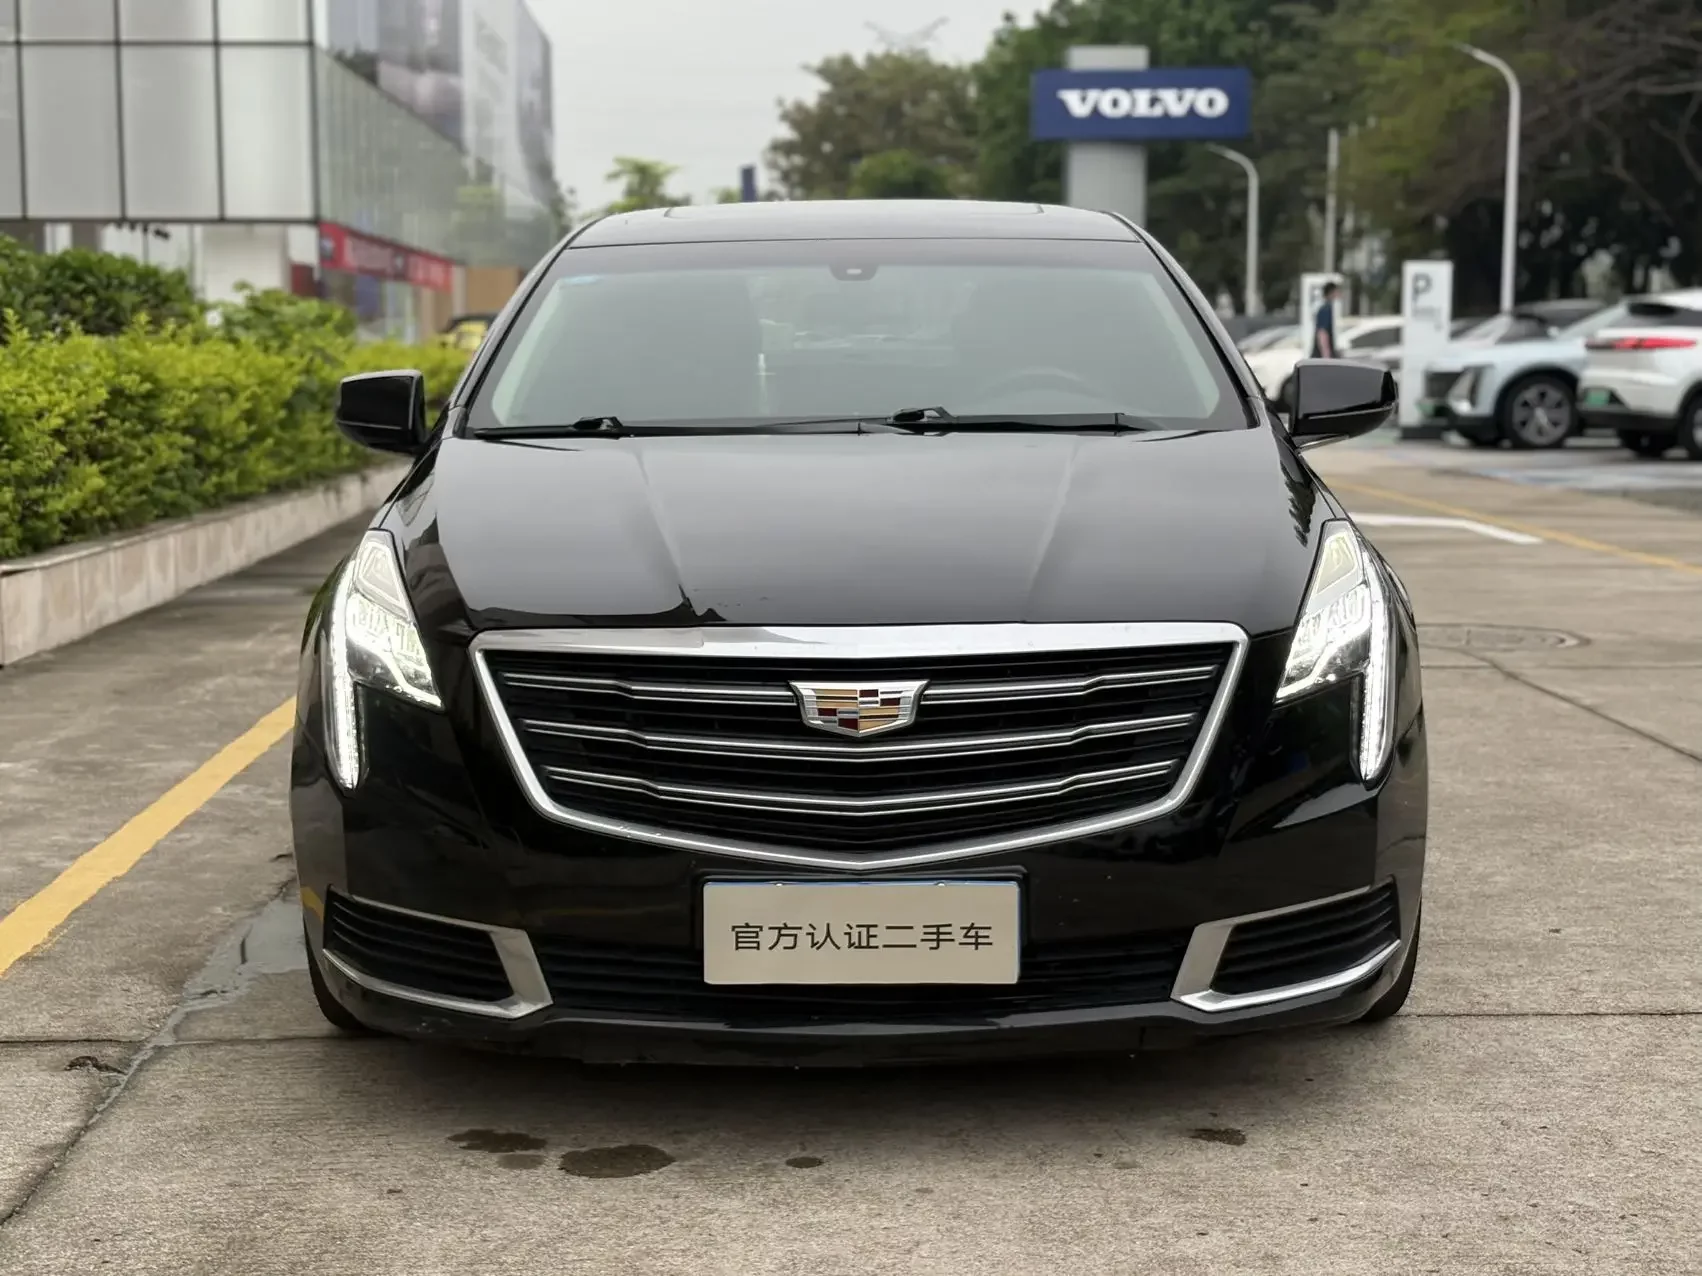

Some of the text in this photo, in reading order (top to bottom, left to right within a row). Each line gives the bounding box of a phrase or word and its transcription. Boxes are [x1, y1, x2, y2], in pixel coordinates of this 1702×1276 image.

[1057, 87, 1230, 119] VOLVO
[1411, 272, 1432, 304] P
[731, 922, 993, 951] 官方认证二手车
